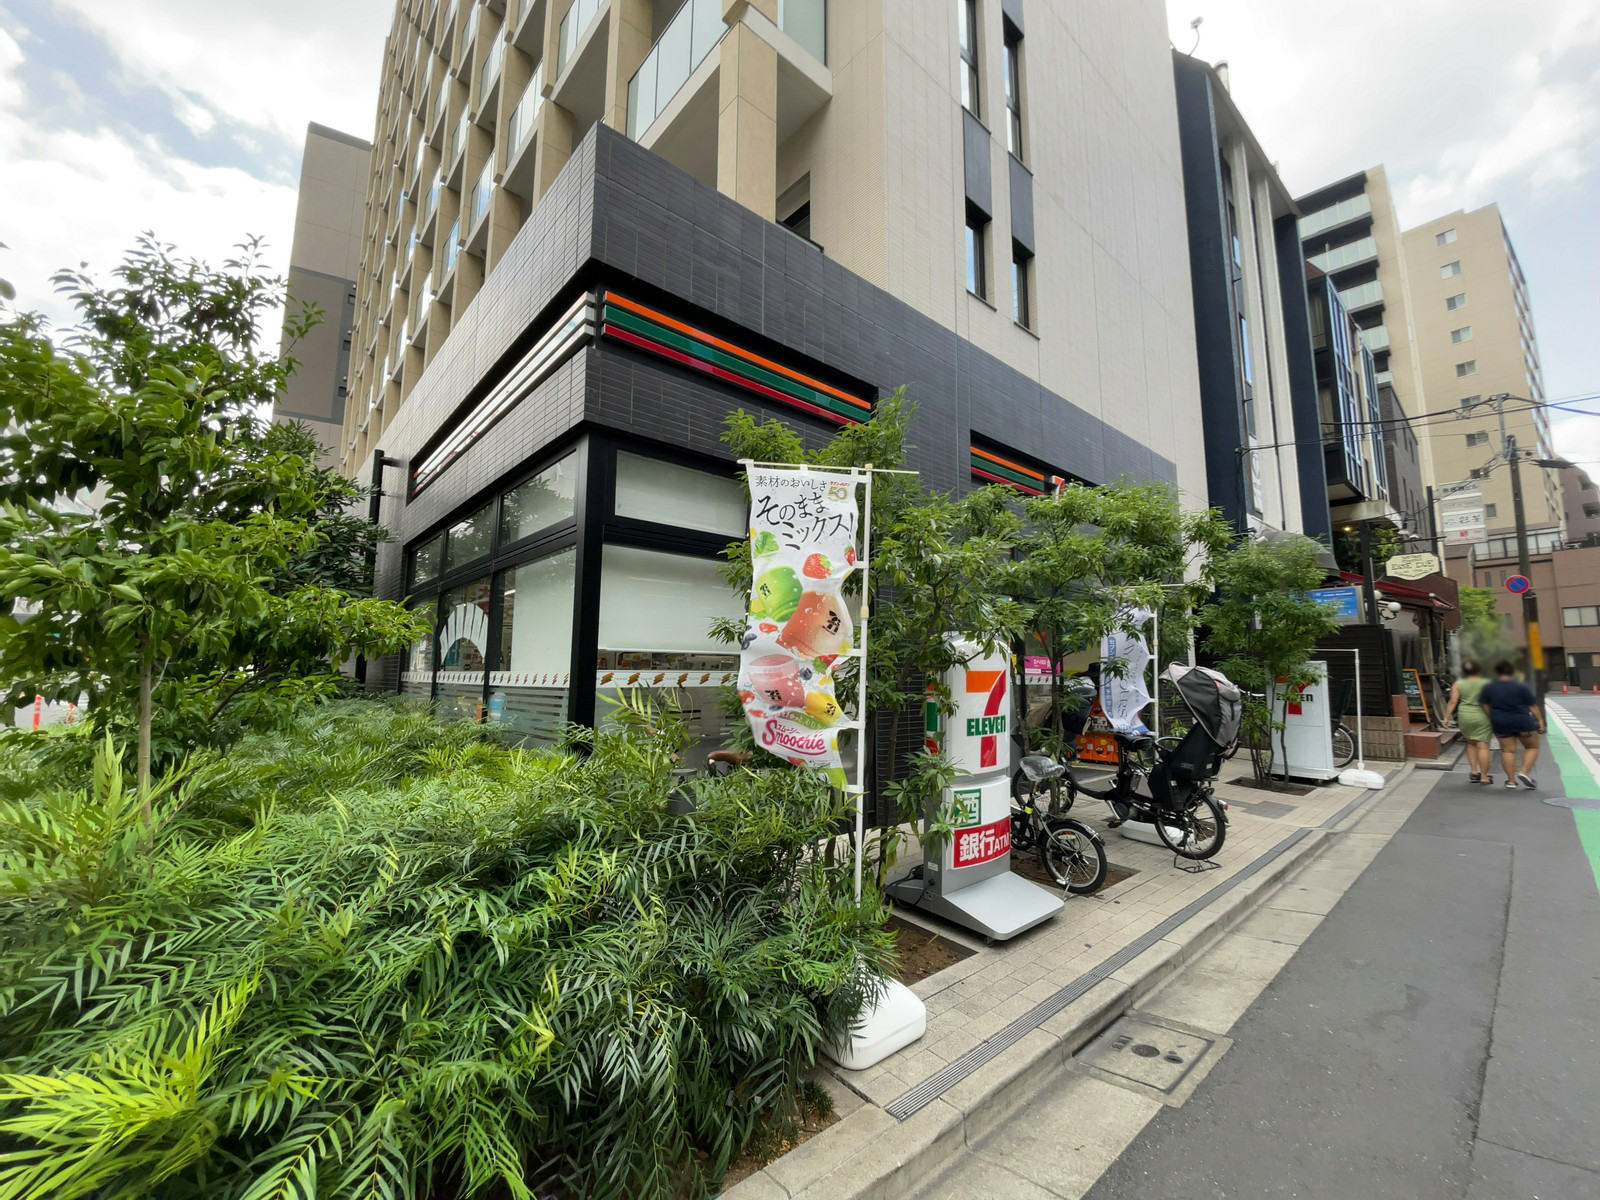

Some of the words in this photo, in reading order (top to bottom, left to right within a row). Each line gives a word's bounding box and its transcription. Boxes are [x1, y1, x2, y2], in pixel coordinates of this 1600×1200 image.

[755, 475, 827, 491] 素材のおいしさ
[756, 492, 829, 526] そのまま
